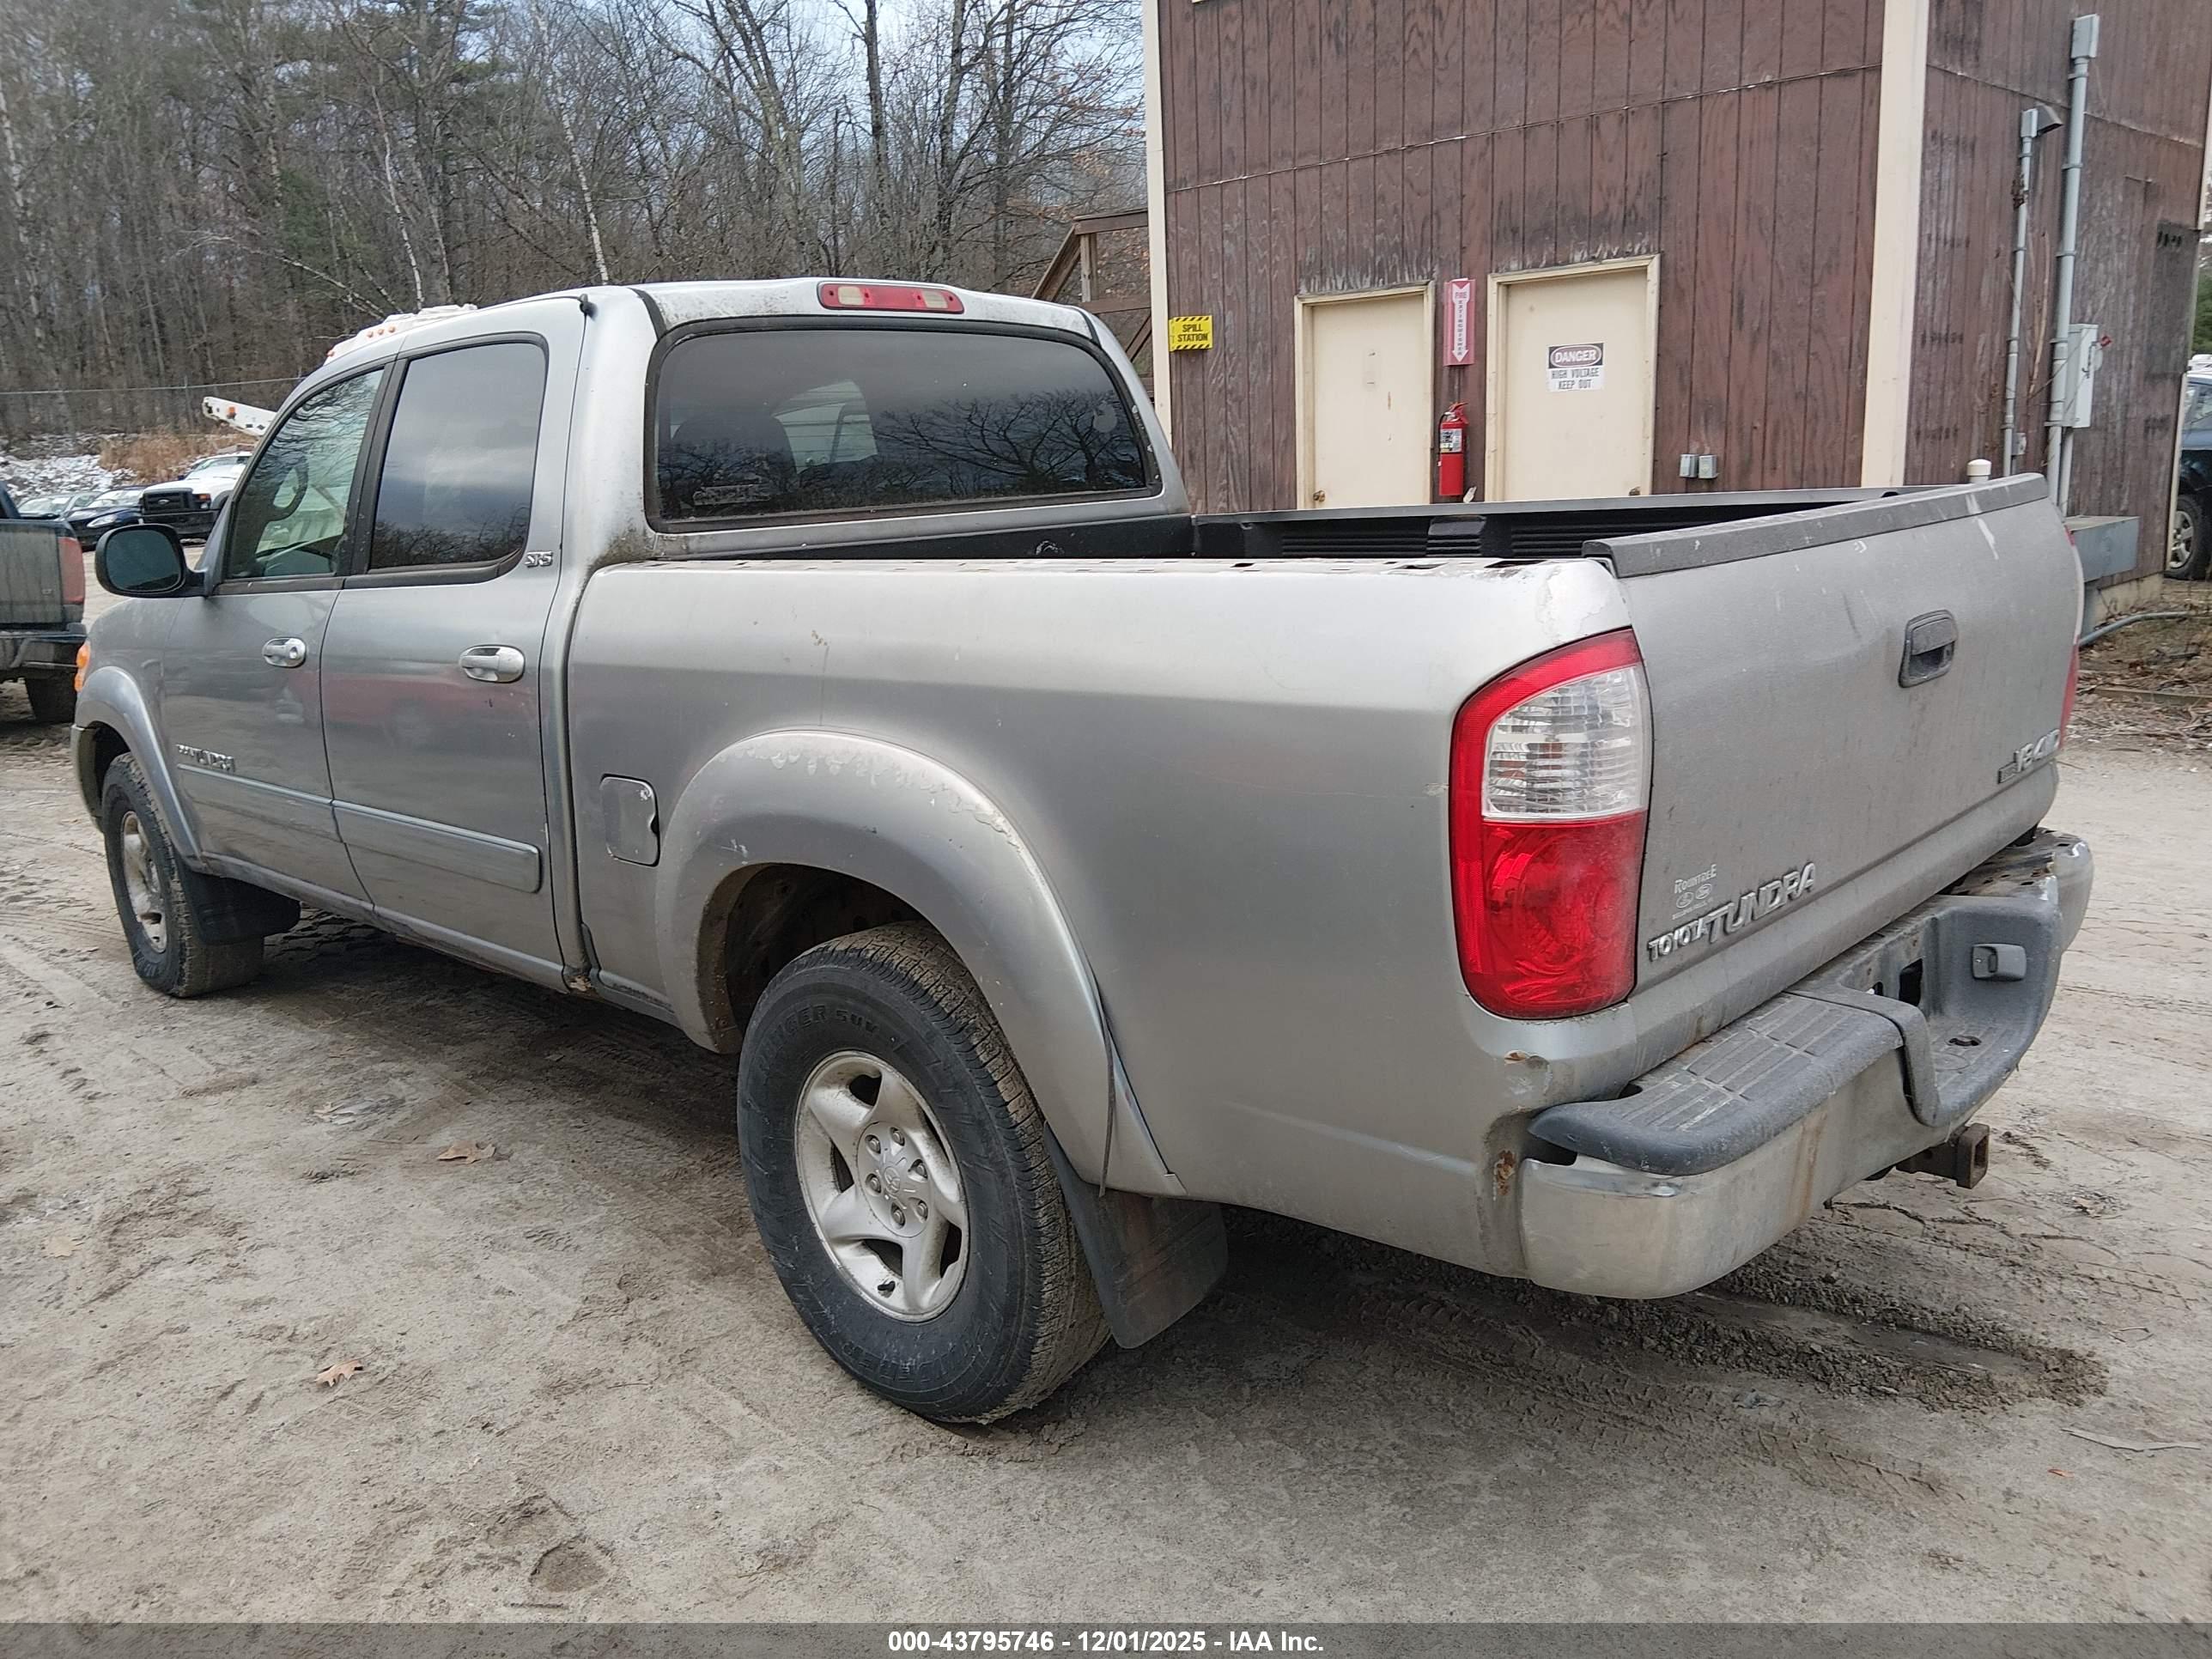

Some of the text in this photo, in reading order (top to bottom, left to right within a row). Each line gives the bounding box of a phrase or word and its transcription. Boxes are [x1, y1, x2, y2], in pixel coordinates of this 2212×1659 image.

[1182, 323, 1203, 333] SPILL
[1176, 333, 1208, 343] STATION
[1554, 349, 1597, 363] DANGER
[1551, 368, 1600, 379] HIGH VOLTAGE
[1559, 379, 1592, 390] KEEP OUT
[524, 550, 553, 567] SR5
[1647, 861, 1816, 962] TOYOTA TUNDRA
